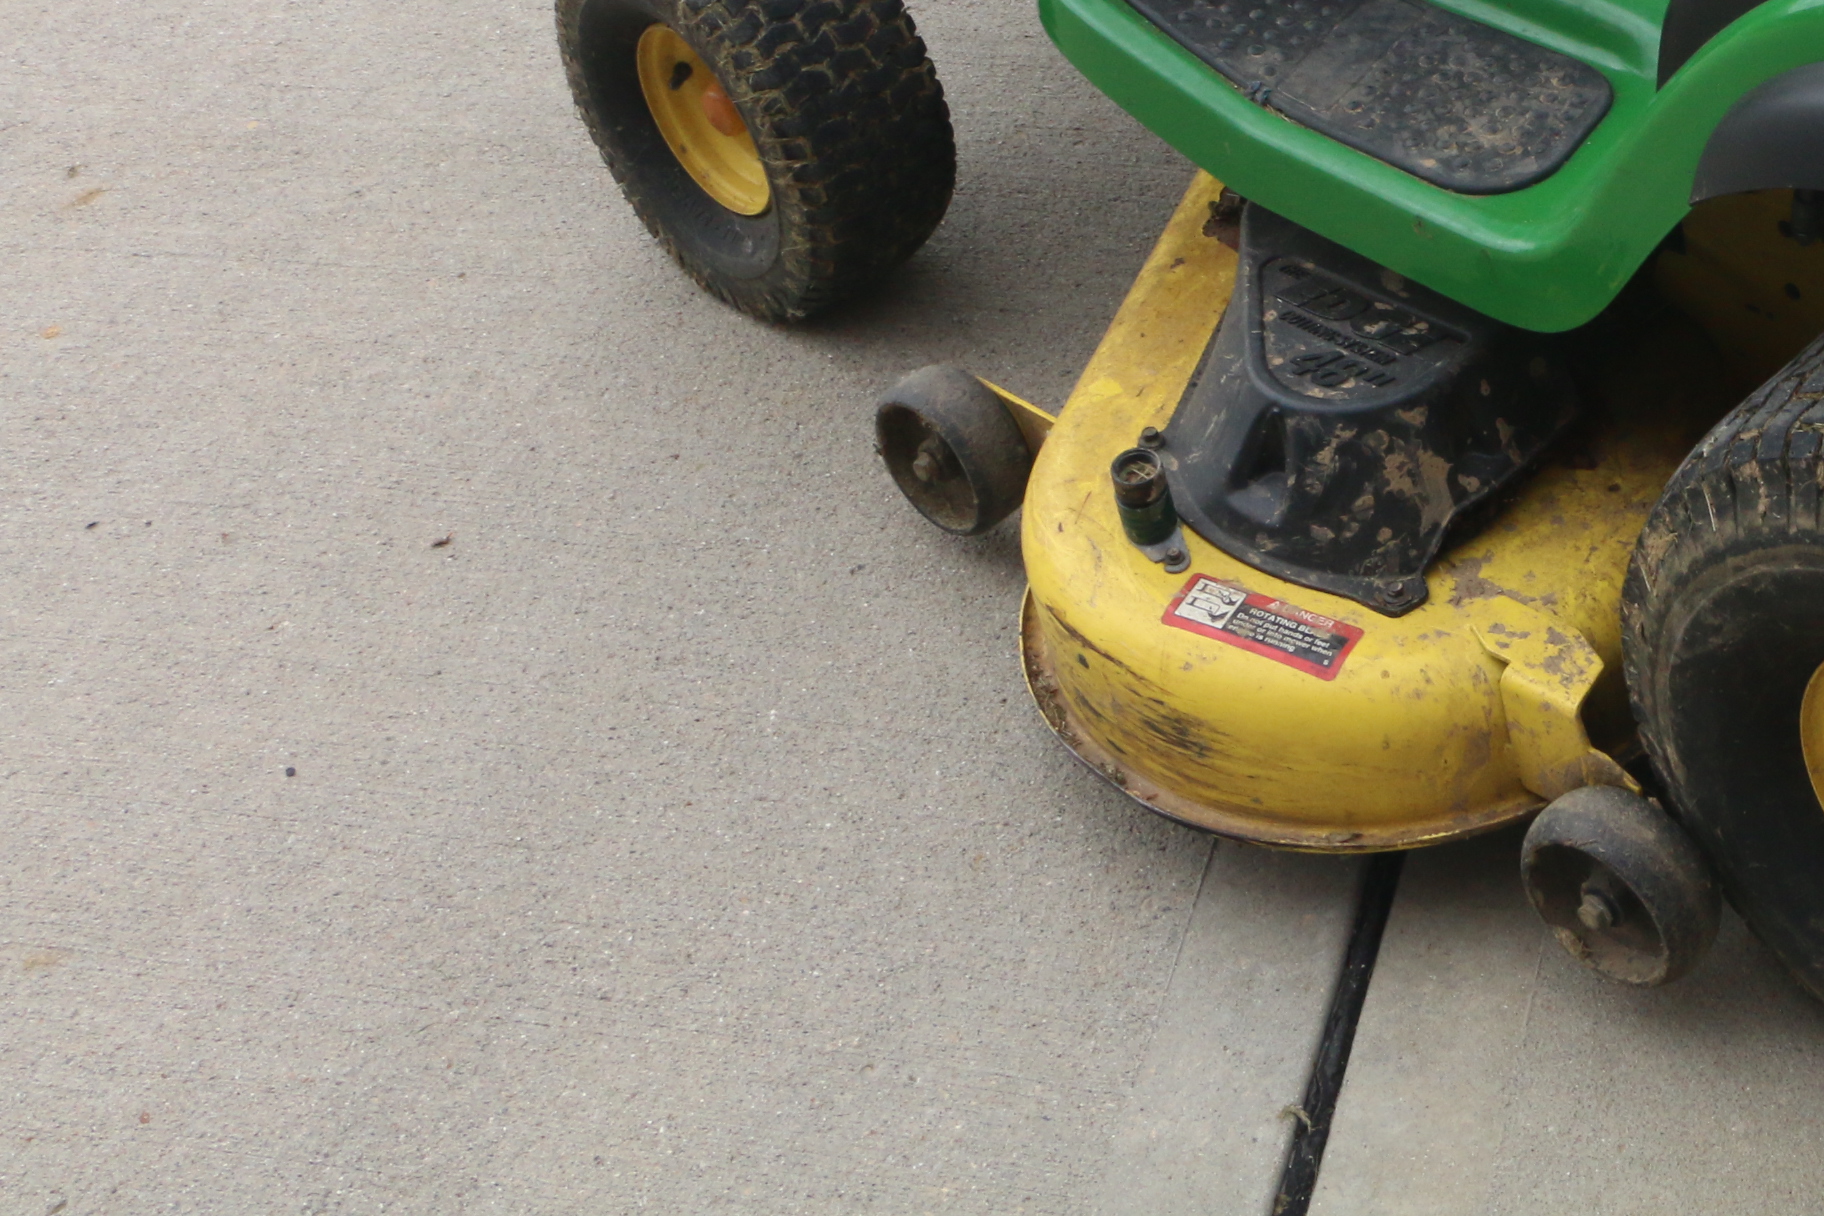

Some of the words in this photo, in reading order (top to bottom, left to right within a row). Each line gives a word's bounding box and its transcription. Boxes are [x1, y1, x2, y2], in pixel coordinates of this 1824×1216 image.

[1249, 607, 1298, 629] ROTATING
[1262, 622, 1279, 630] put
[1279, 625, 1303, 639] hands
[1314, 639, 1330, 648] feet
[1311, 645, 1333, 657] when
